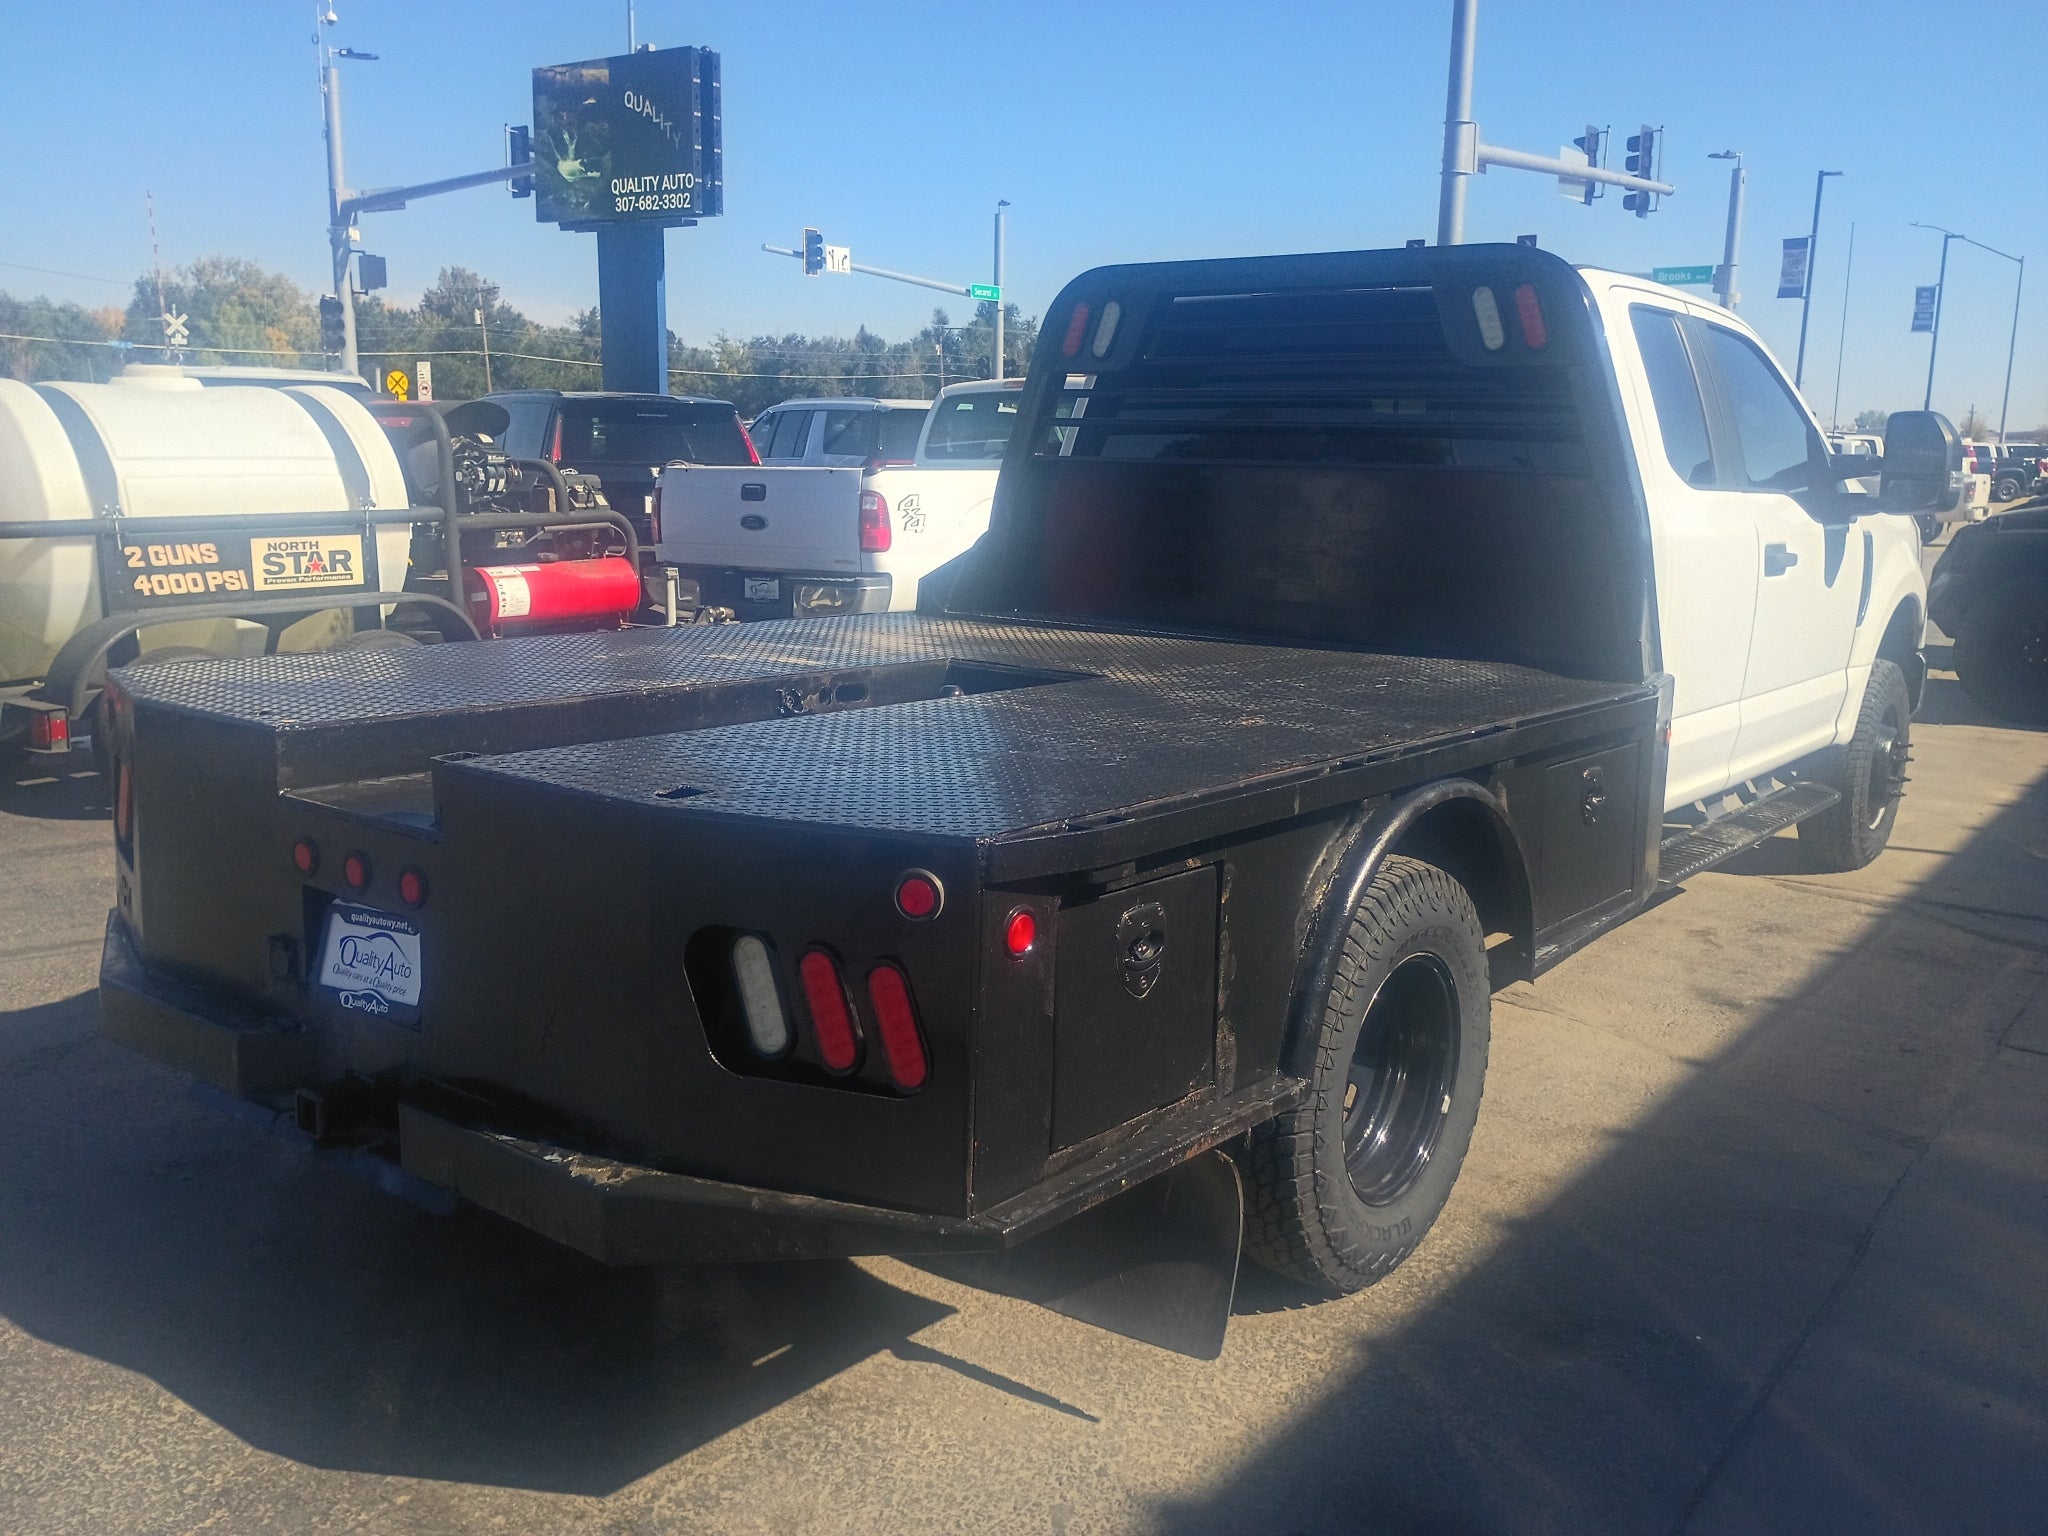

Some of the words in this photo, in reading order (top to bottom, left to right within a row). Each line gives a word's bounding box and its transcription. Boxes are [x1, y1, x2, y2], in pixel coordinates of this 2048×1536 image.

[624, 90, 681, 150] QUALITY
[611, 175, 659, 195] QUALITY
[661, 172, 694, 190] AUTO
[615, 193, 691, 212] 307-682-3302
[1658, 271, 1691, 281] Brooks
[974, 287, 992, 297] Second
[124, 546, 145, 568] 2
[148, 542, 219, 567] GUNS
[267, 540, 319, 552] NORTH
[262, 549, 352, 576] STAR
[133, 572, 205, 597] 4000
[204, 569, 249, 592] PSI
[298, 574, 352, 582] Performance
[351, 913, 408, 930] qualityautowy.net
